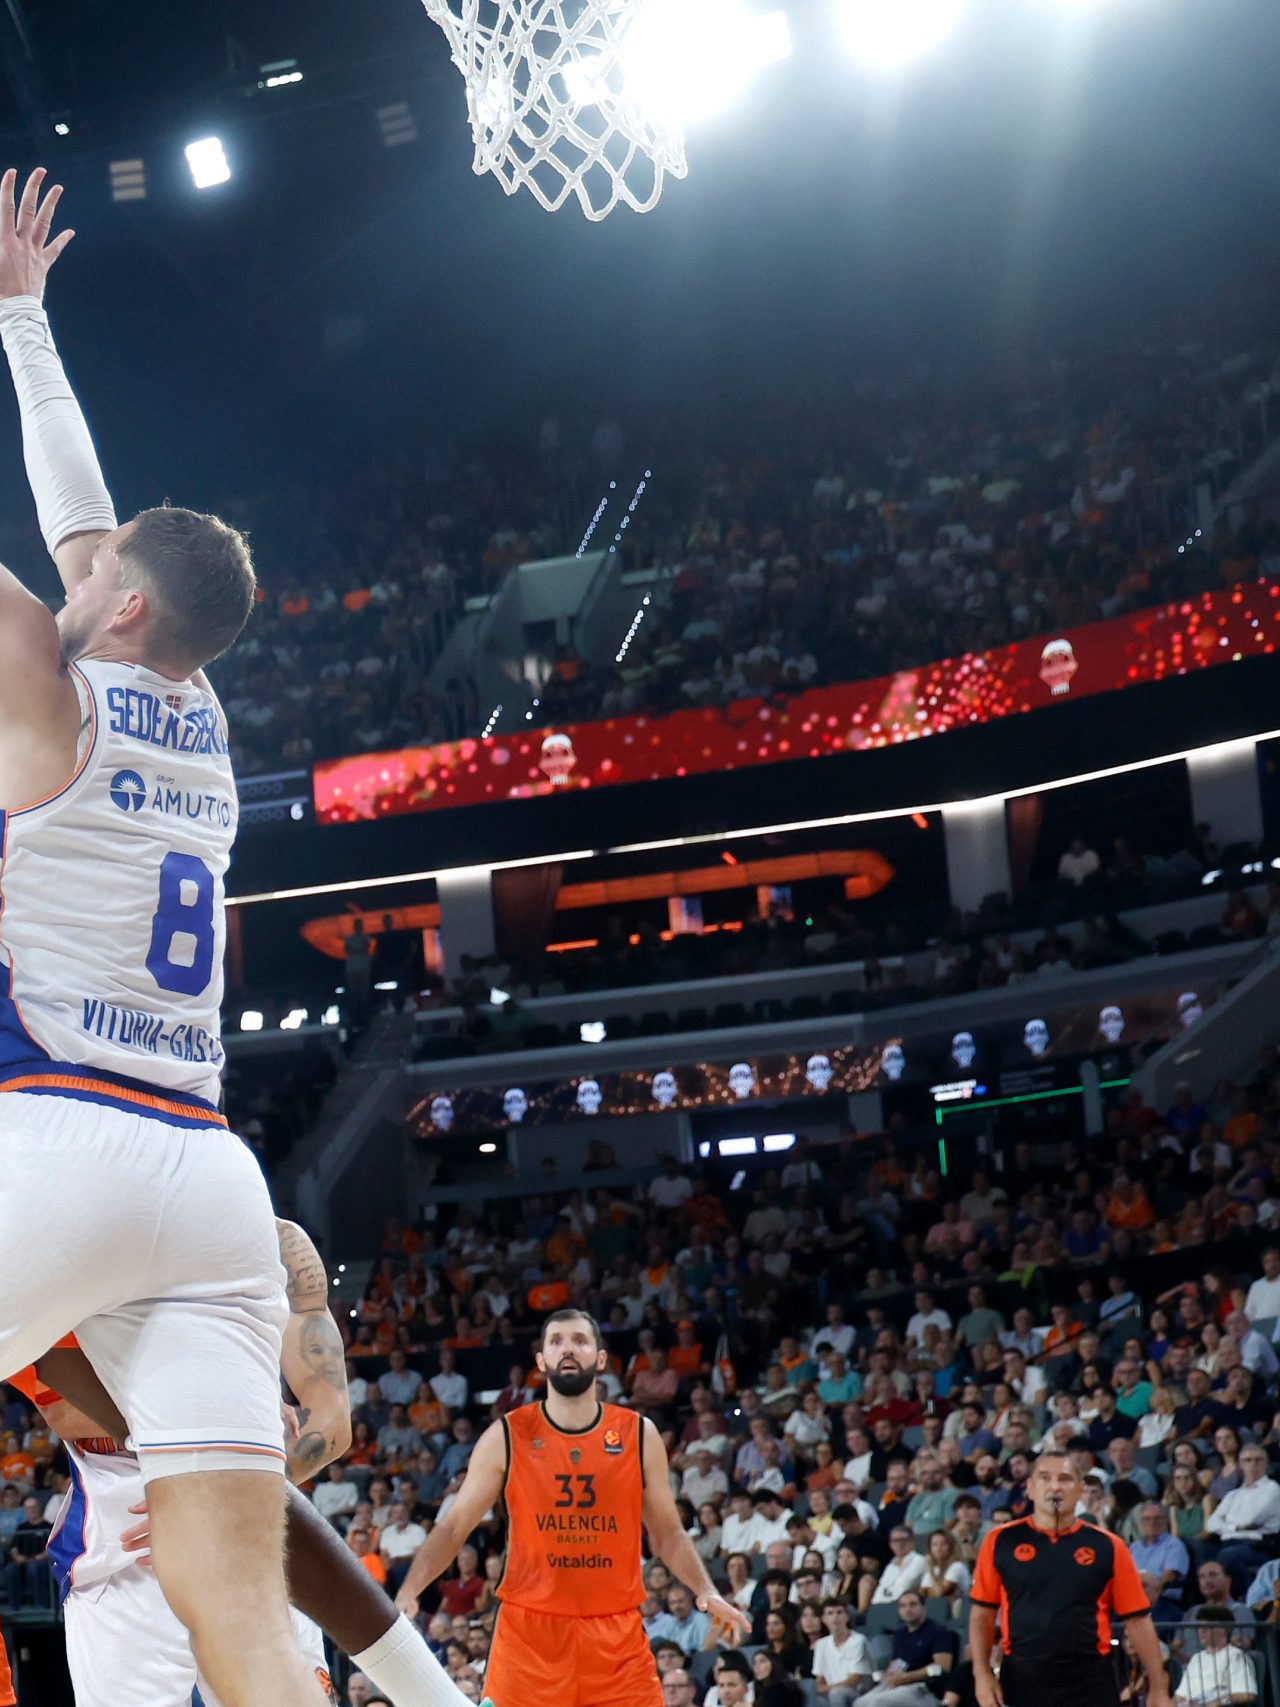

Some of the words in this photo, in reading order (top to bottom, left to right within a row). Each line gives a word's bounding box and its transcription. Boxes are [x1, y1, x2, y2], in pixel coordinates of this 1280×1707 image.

[152, 786, 231, 828] AMUTIO
[145, 850, 215, 997] 8
[554, 1474, 597, 1508] 33
[535, 1514, 618, 1534] VALENCIA
[556, 1535, 599, 1545] BASKET
